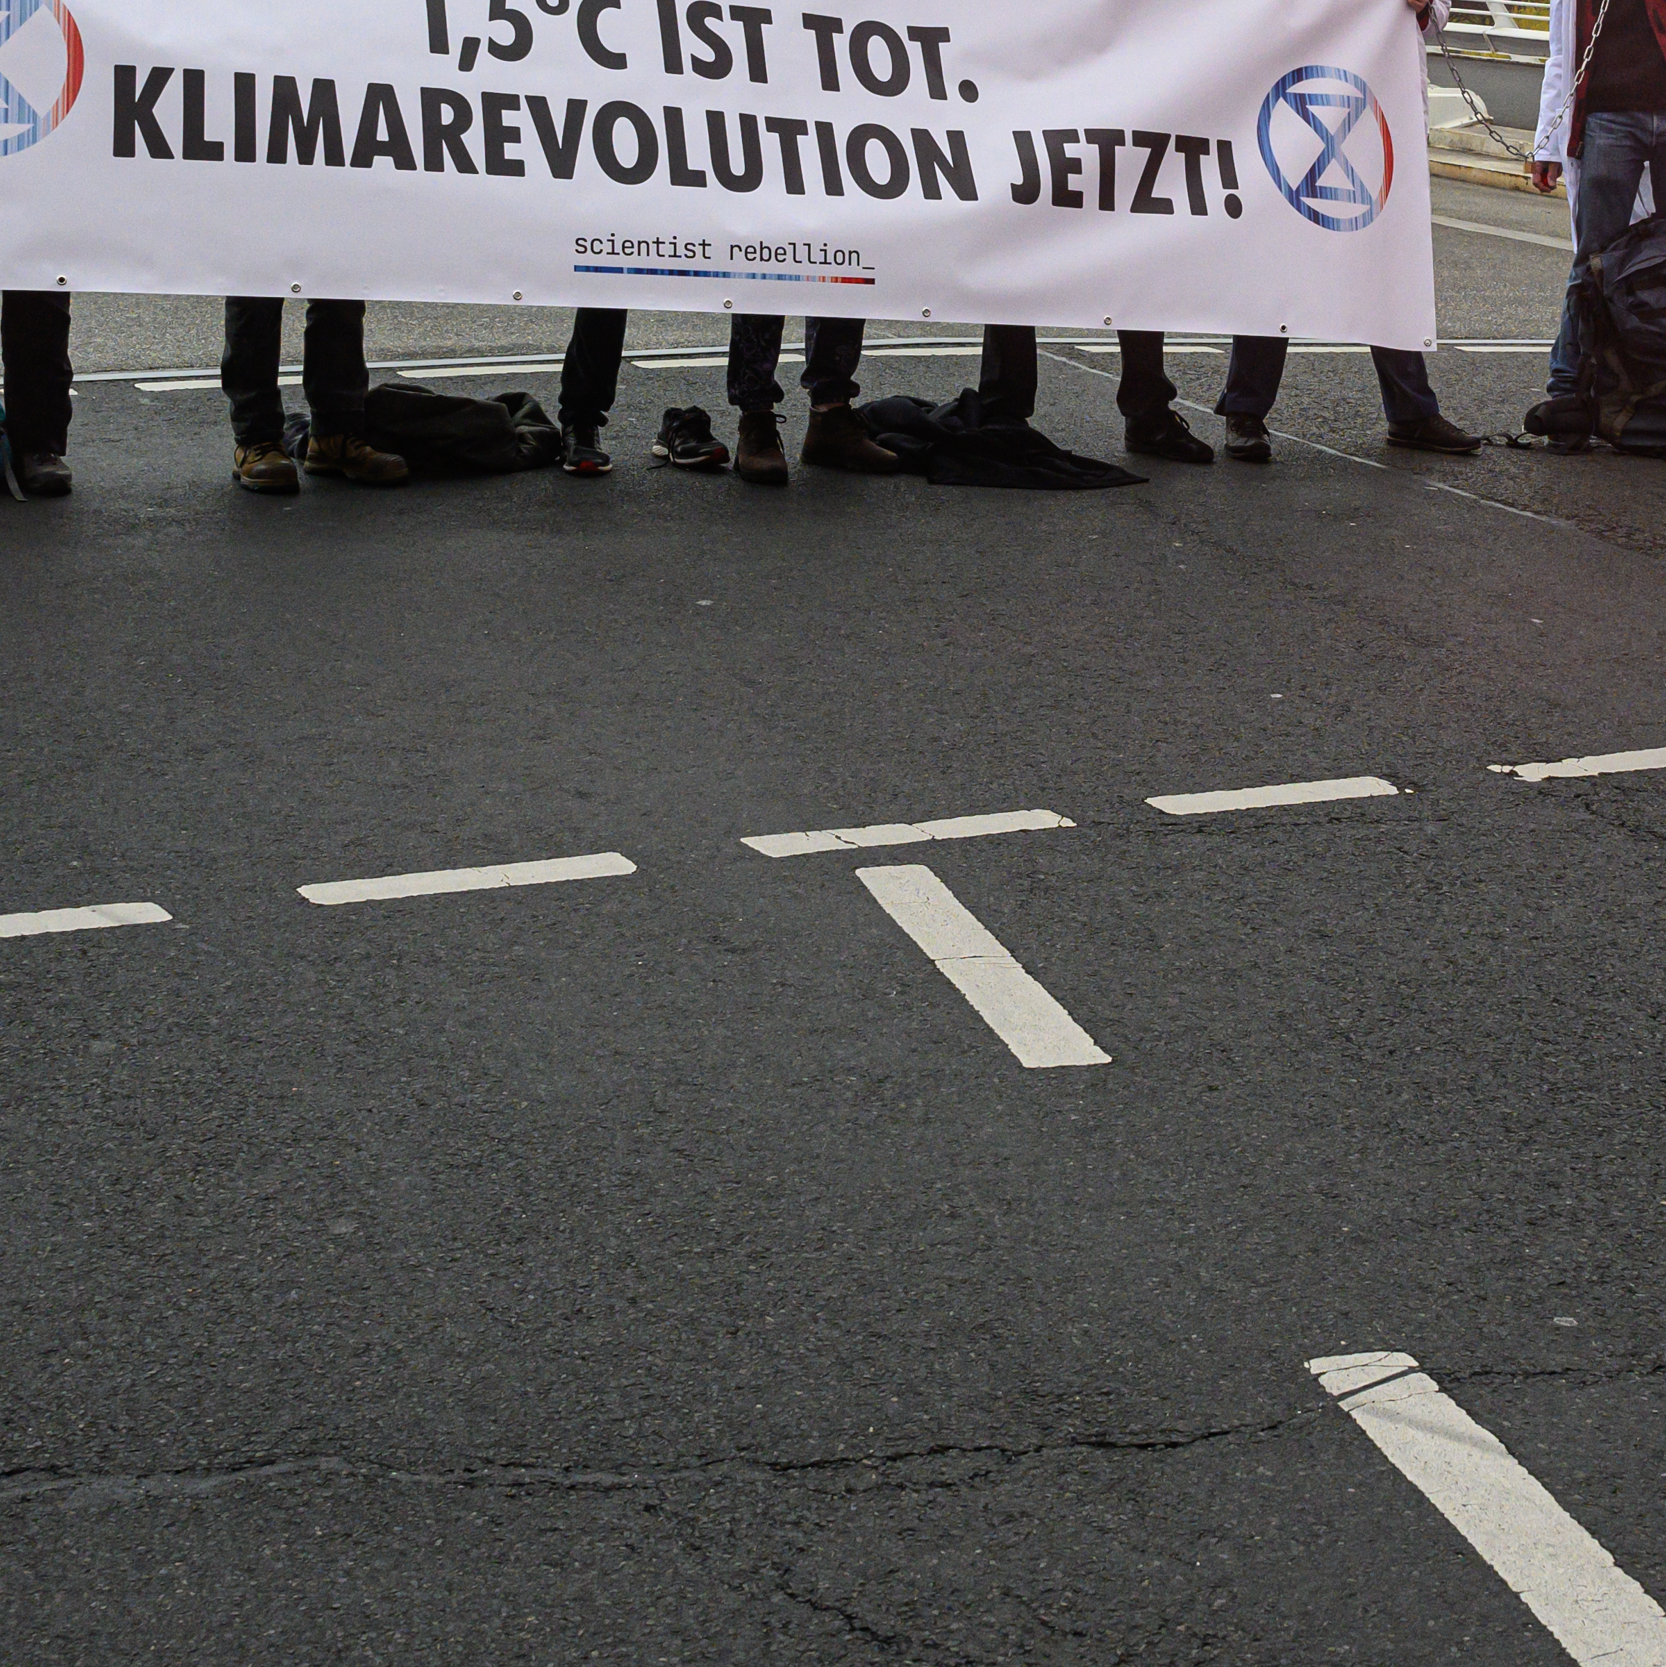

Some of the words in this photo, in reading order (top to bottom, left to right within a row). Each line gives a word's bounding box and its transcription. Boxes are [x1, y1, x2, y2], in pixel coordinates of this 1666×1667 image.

[801, 12, 979, 103] TOT.
[112, 64, 979, 201] KLIMAREVOLUTION
[1010, 128, 1243, 220] JETZT!
[574, 232, 712, 260] scientist
